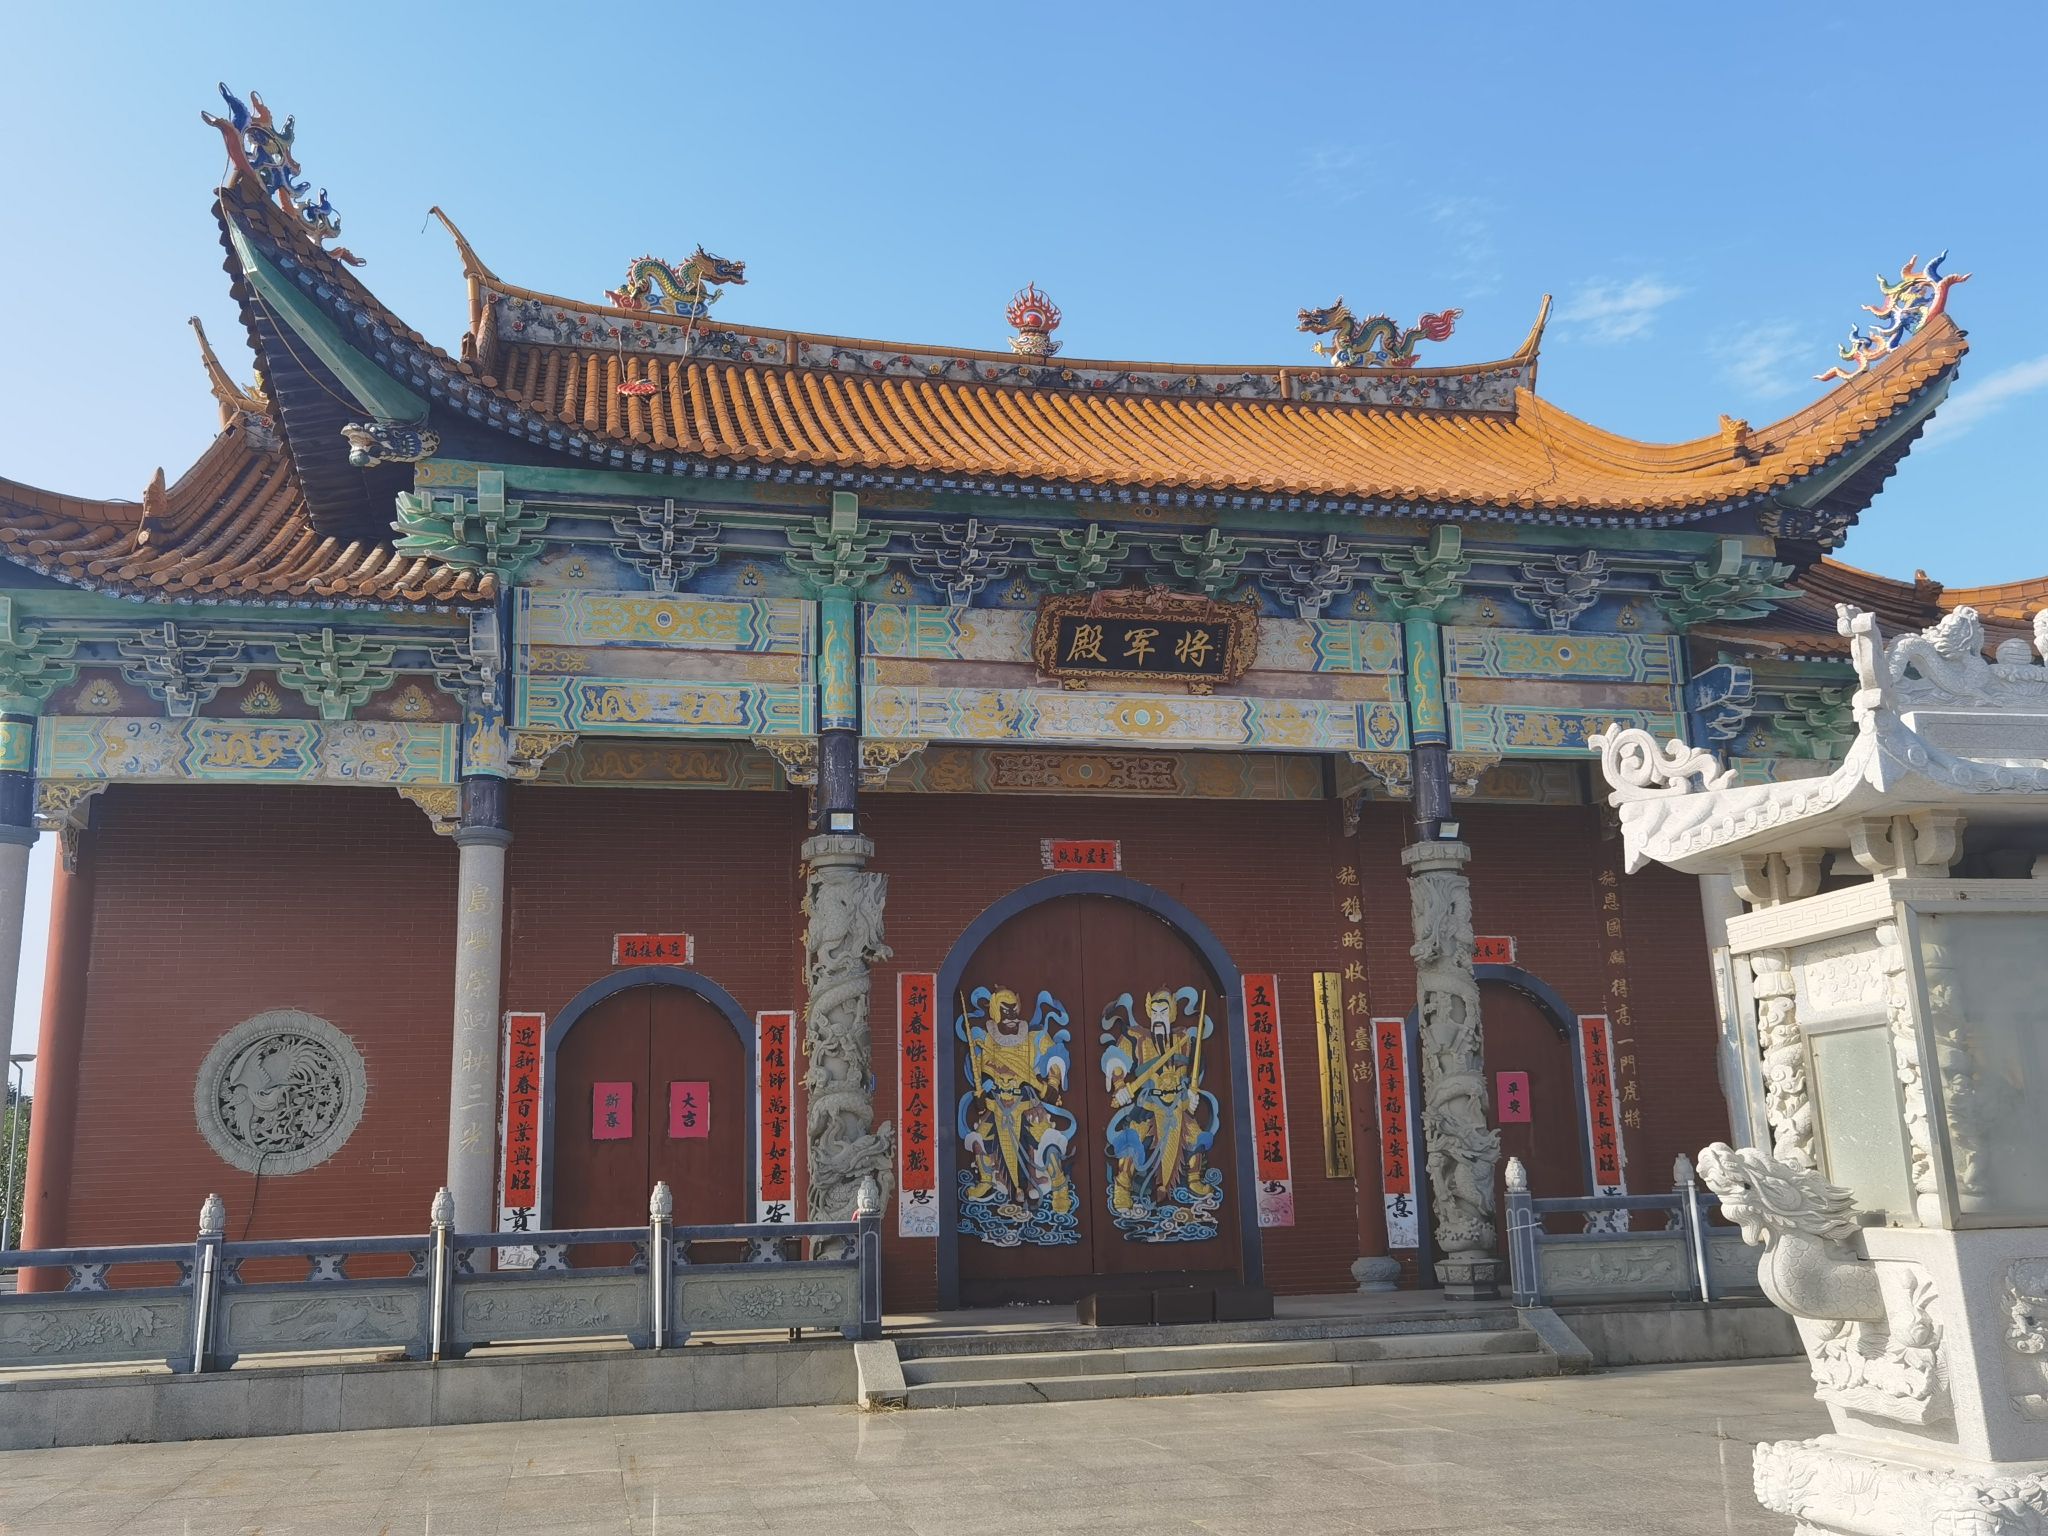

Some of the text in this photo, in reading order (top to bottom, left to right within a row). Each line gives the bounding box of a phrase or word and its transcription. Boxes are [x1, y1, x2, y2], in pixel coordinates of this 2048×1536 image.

[510, 1027, 537, 1191] 迎新春百業興旺
[604, 1092, 621, 1129] 新春
[681, 1092, 698, 1128] 大吉
[1250, 986, 1284, 1164] 五福臨門家興旺
[1381, 1032, 1405, 1179] 家庭幸福永安康
[1507, 1081, 1521, 1114] 平安
